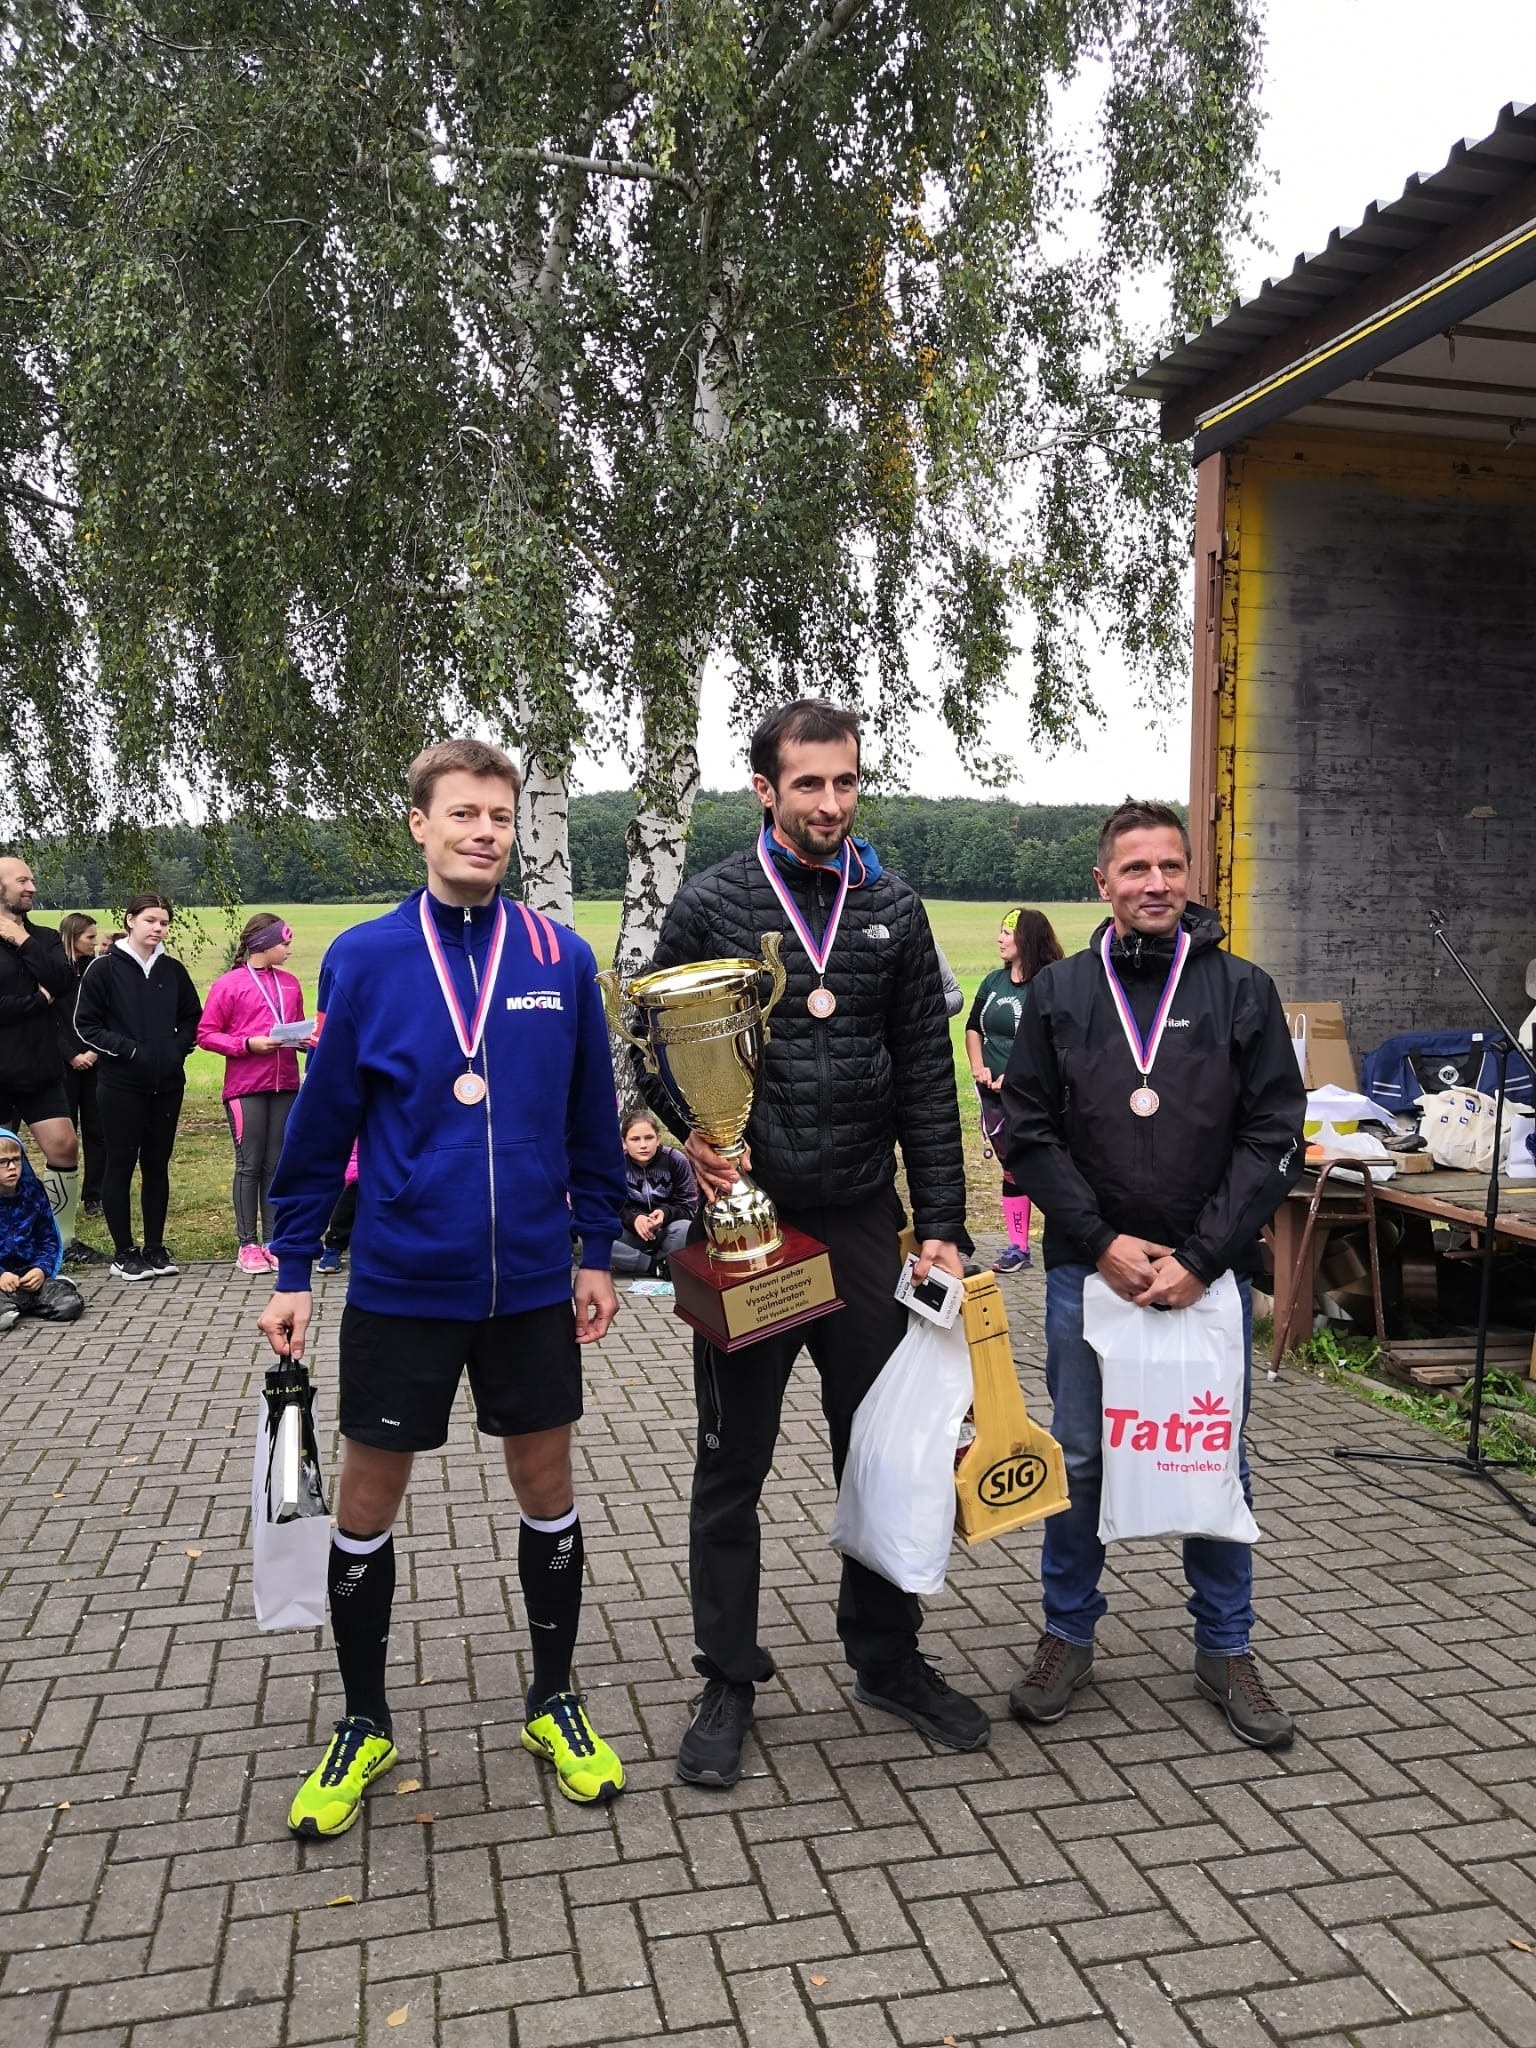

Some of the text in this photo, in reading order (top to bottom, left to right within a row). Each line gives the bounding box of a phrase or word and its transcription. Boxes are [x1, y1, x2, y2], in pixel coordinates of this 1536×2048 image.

[506, 996, 564, 1011] MOGUL
[746, 1277, 812, 1308] Vysocký krosový
[749, 1267, 805, 1293] Putovní pohár
[757, 1290, 805, 1315] půlmaraton
[1104, 1408, 1232, 1453] Tatra
[990, 1460, 1034, 1499] SIG
